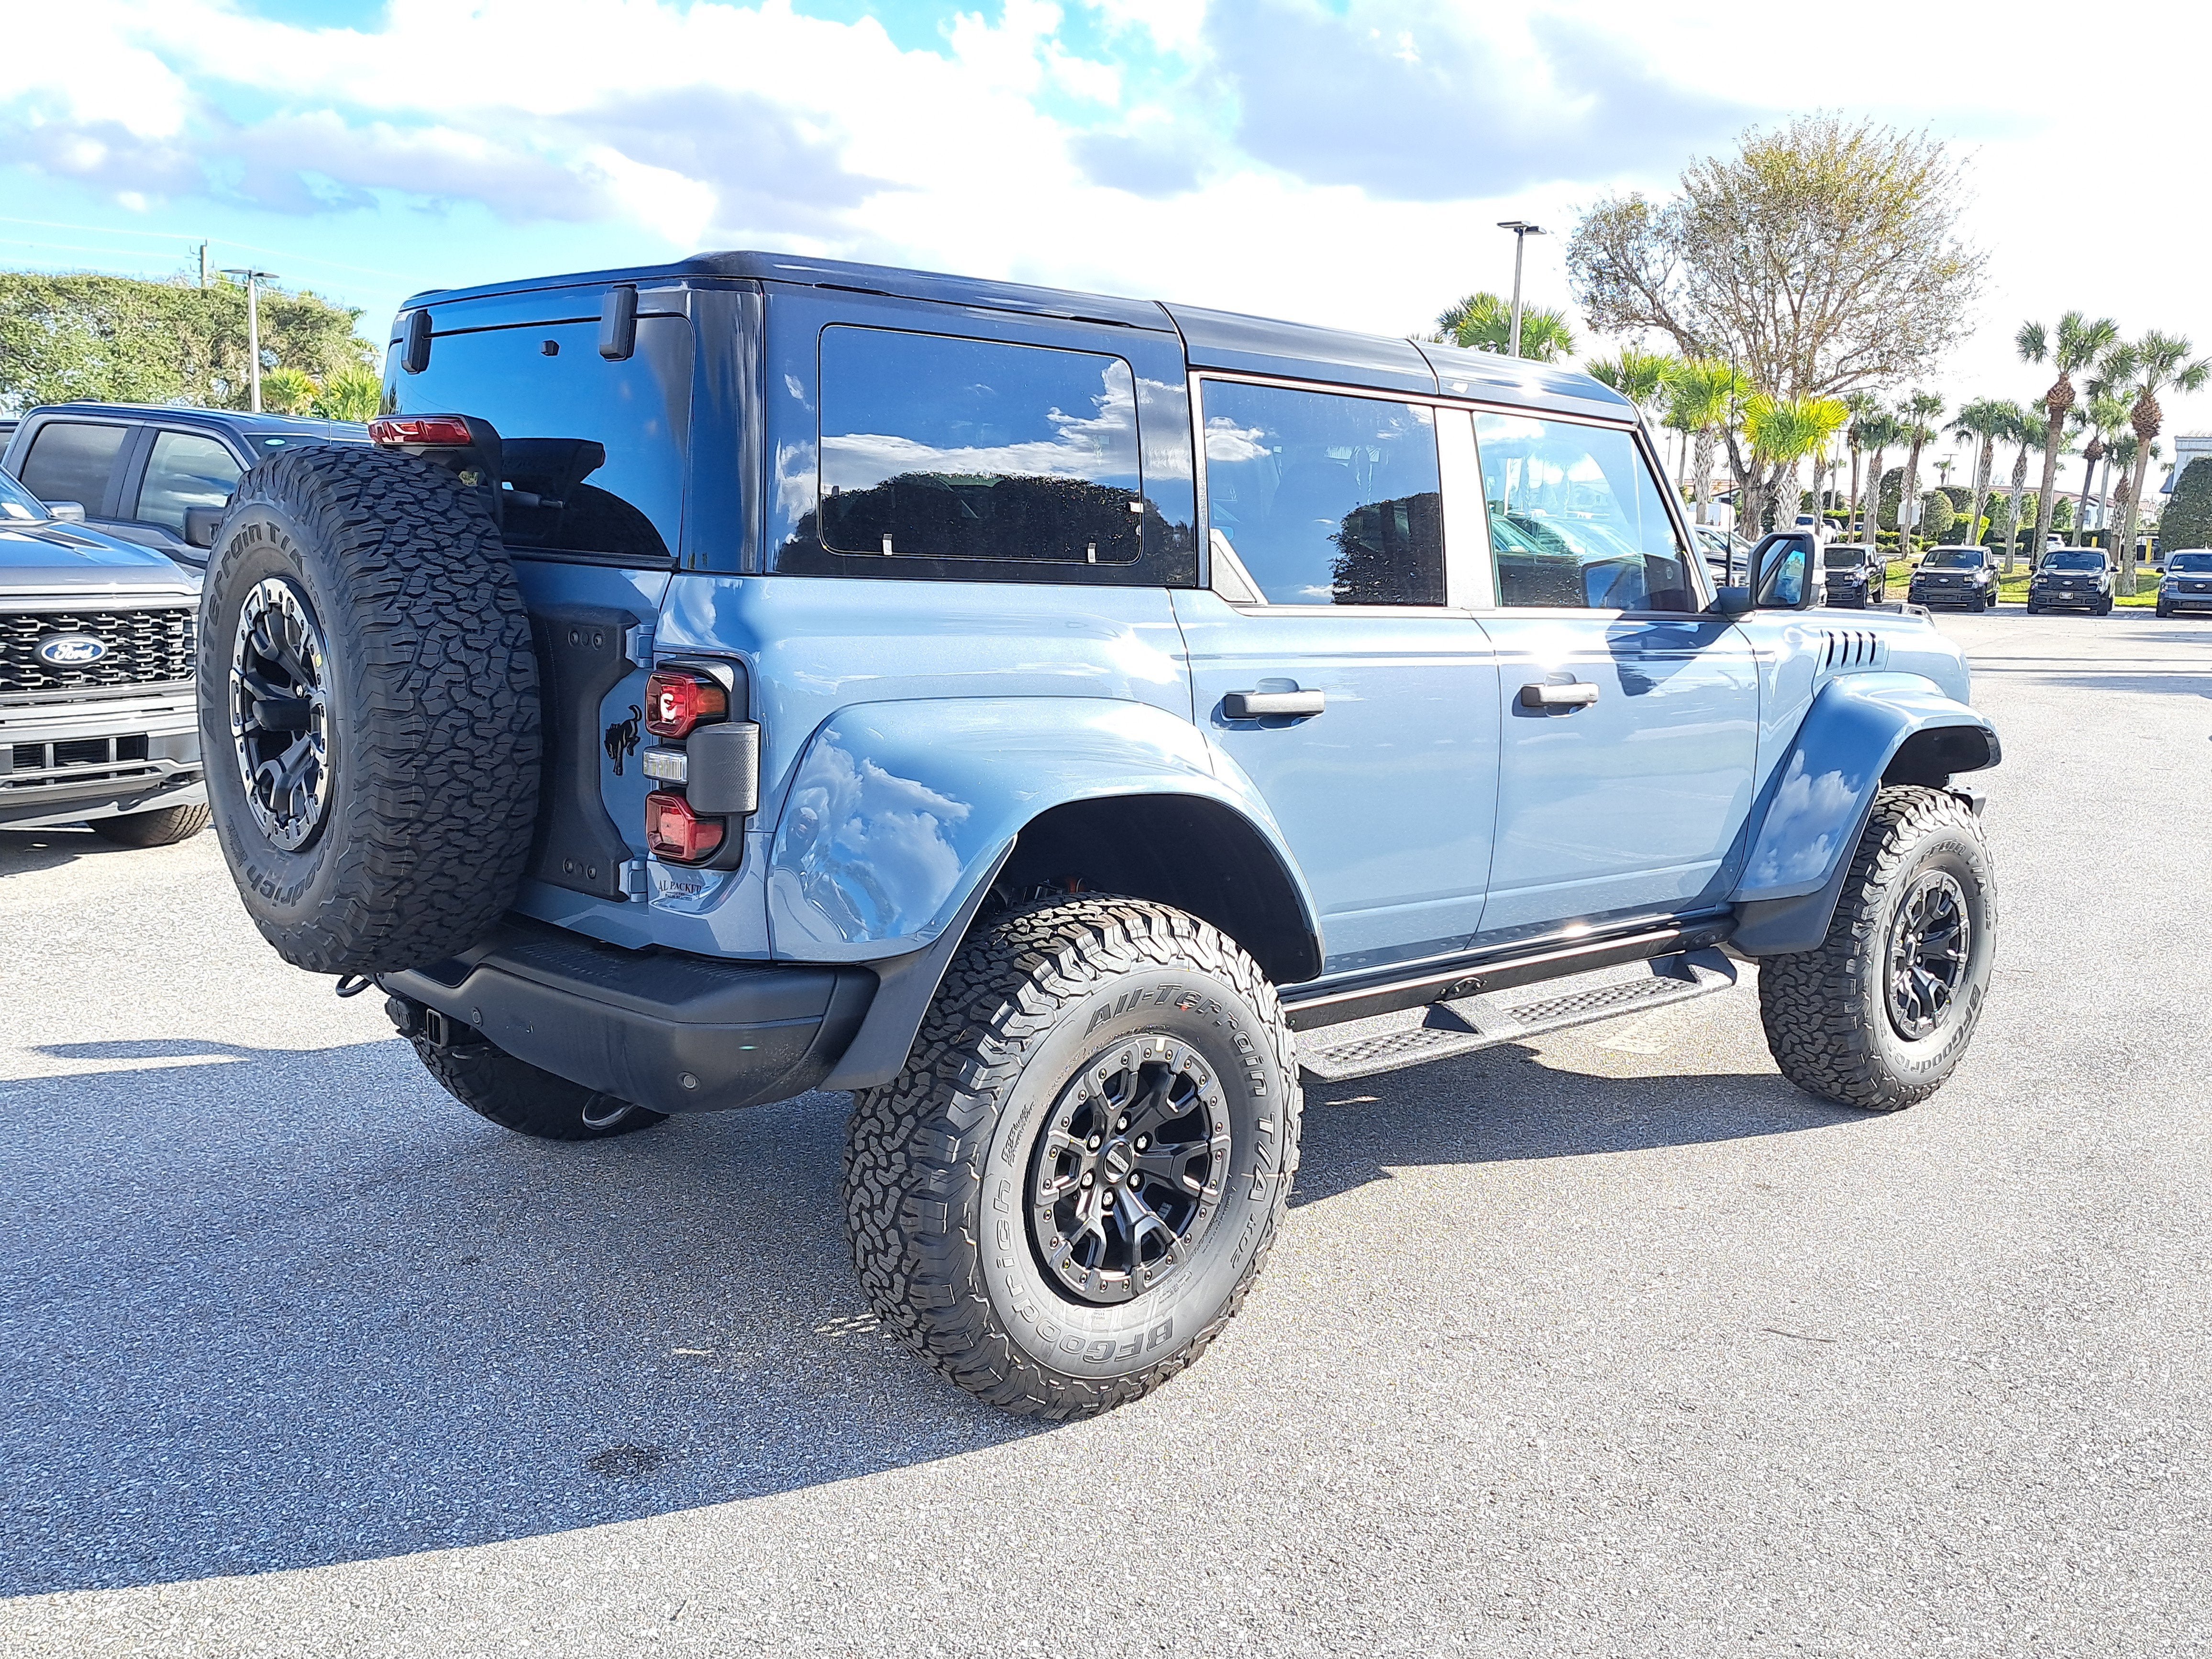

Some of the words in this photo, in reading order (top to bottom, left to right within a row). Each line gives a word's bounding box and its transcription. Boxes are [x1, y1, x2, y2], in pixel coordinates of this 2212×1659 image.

[54, 642, 94, 660] Ford
[659, 880, 669, 891] AL
[670, 881, 702, 896] PACKER
[1083, 983, 1268, 1097] All-Terrain
[1248, 1111, 1276, 1202] T/A
[993, 1177, 1173, 1363] BFGoodrich
